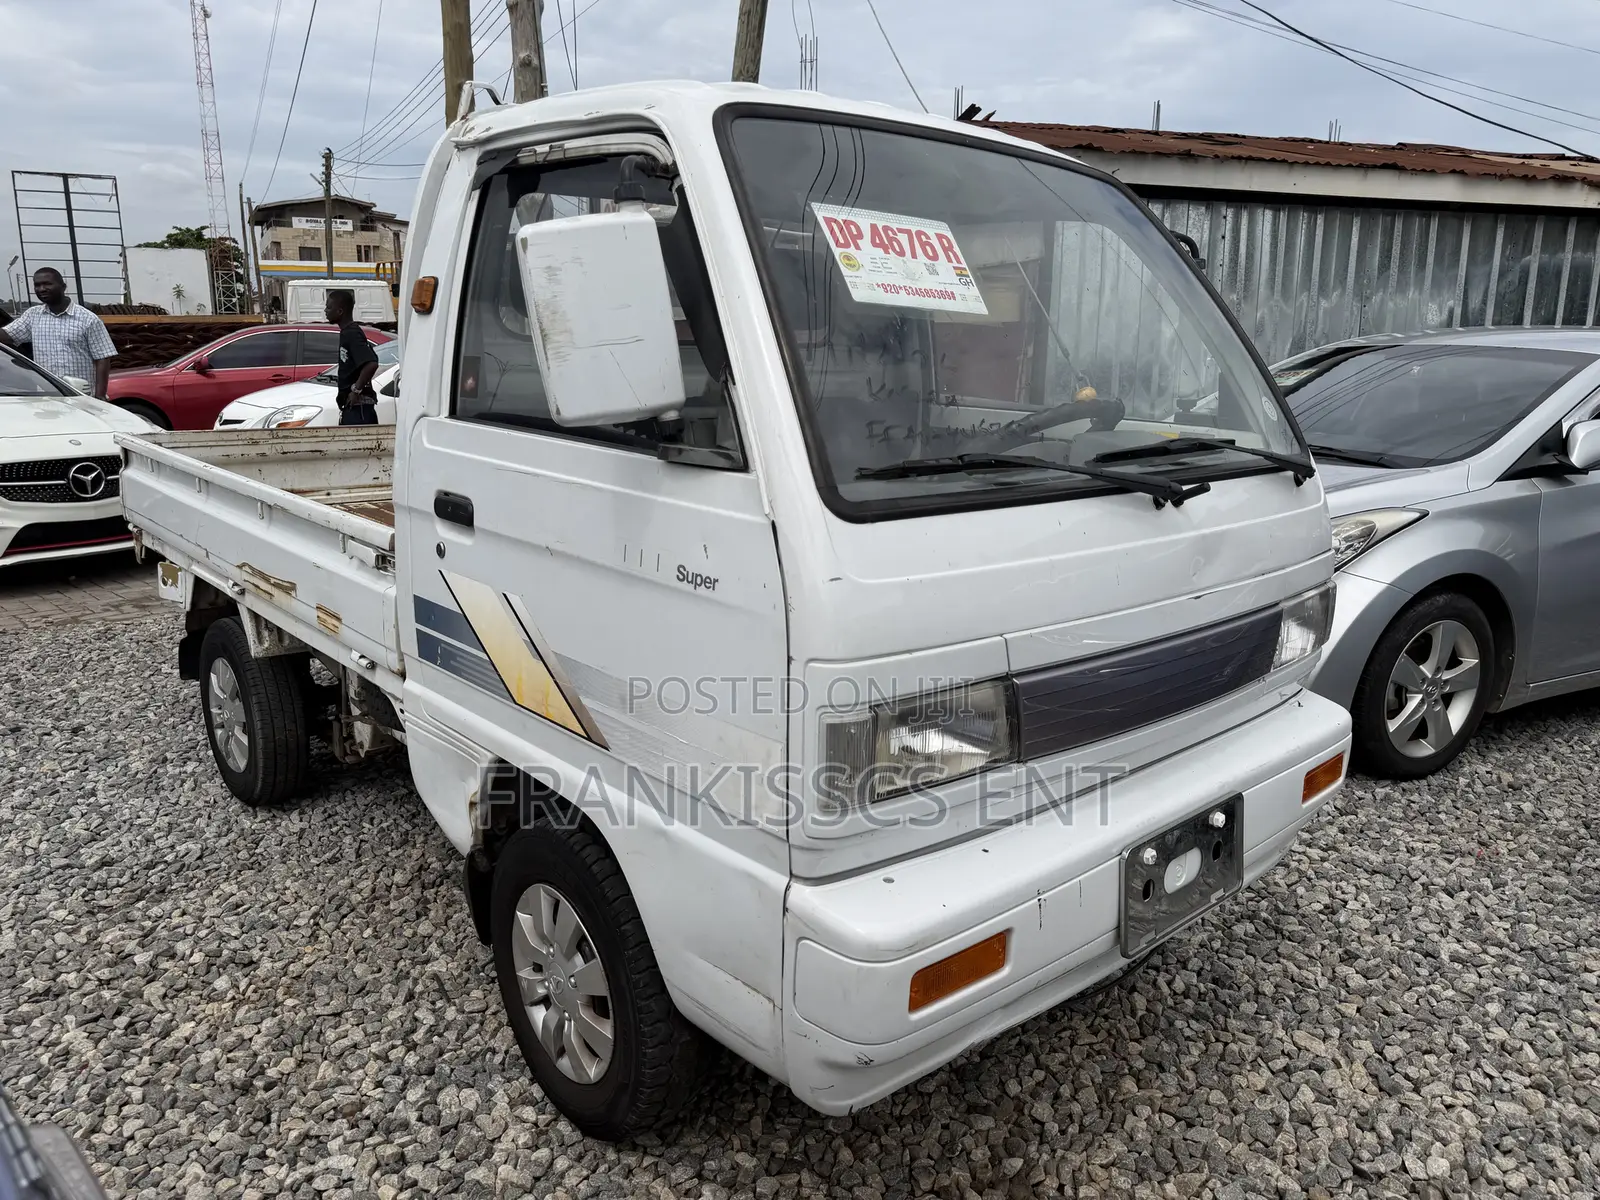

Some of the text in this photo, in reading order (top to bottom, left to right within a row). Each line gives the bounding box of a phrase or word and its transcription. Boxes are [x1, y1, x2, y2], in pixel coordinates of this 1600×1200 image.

[822, 215, 864, 251] DP
[869, 223, 940, 262] 4676
[934, 232, 963, 265] R
[958, 277, 975, 288] GH
[676, 564, 719, 591] Super
